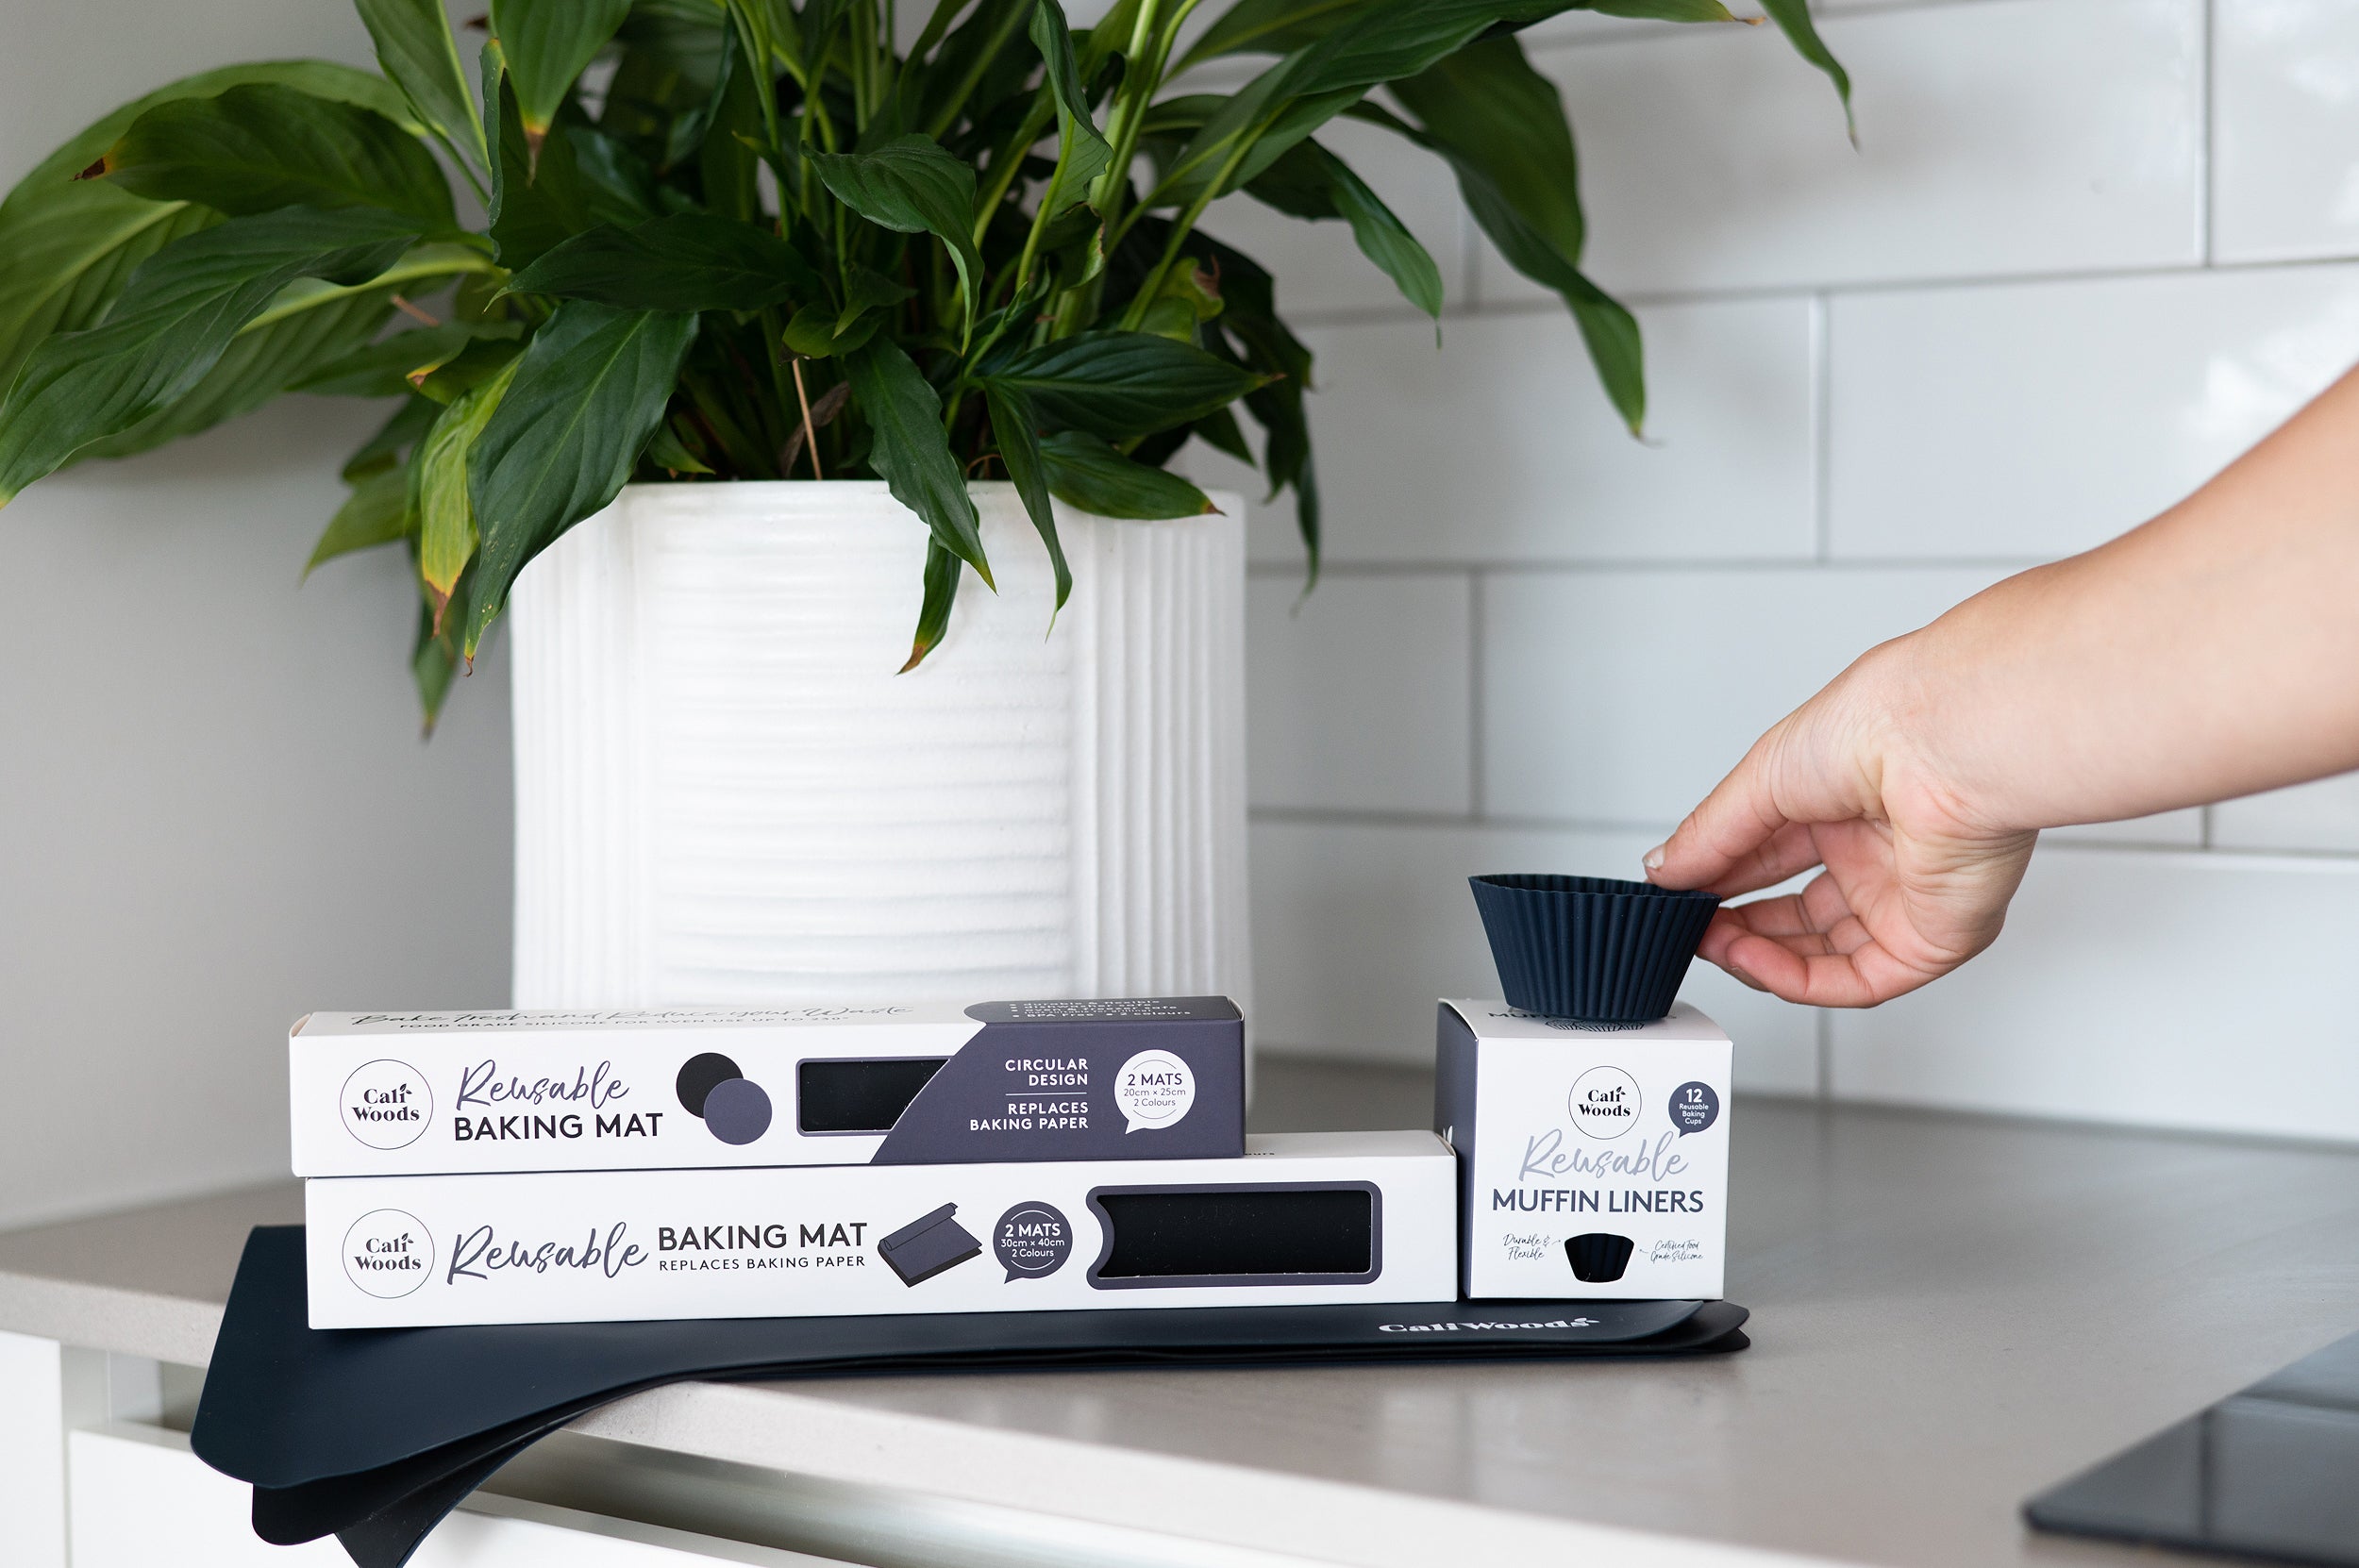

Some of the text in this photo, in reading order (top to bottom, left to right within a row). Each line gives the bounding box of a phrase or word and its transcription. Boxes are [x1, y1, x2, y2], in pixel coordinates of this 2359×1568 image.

[351, 1014, 447, 1025] Bake
[1005, 1058, 1089, 1072] CIRCULAR
[456, 1059, 629, 1110] Reusable
[1029, 1074, 1088, 1086] DESIGN
[1128, 1073, 1182, 1086] 2 MATS
[363, 1084, 412, 1105] Cali
[1124, 1088, 1149, 1097] 20cm
[1161, 1088, 1186, 1096] 25cm
[1587, 1086, 1626, 1102] Cali
[1685, 1088, 1703, 1103] 12
[1008, 1102, 1089, 1115] REPLACES
[1133, 1097, 1176, 1107] 2 Colours
[352, 1107, 420, 1122] Woods
[1577, 1104, 1631, 1117] Woods
[454, 1112, 662, 1141] BAKING MAT
[970, 1117, 1089, 1131] BAKING PAPER
[1518, 1128, 1689, 1182] Reusable
[1492, 1189, 1704, 1213] MUFFIN LINERS
[659, 1223, 867, 1251] BAKING MAT
[1005, 1223, 1061, 1237] 2 MATS
[365, 1232, 414, 1254] Cali
[1000, 1239, 1027, 1247] 30cm
[1038, 1238, 1064, 1246] 40cm
[1502, 1233, 1542, 1246] Durable
[446, 1222, 649, 1285] Reusable
[1012, 1248, 1054, 1258] 2 Colours
[1508, 1246, 1545, 1260] Flexible
[354, 1256, 422, 1271] Woods
[660, 1256, 865, 1272] REPLACES BAKING PAPER
